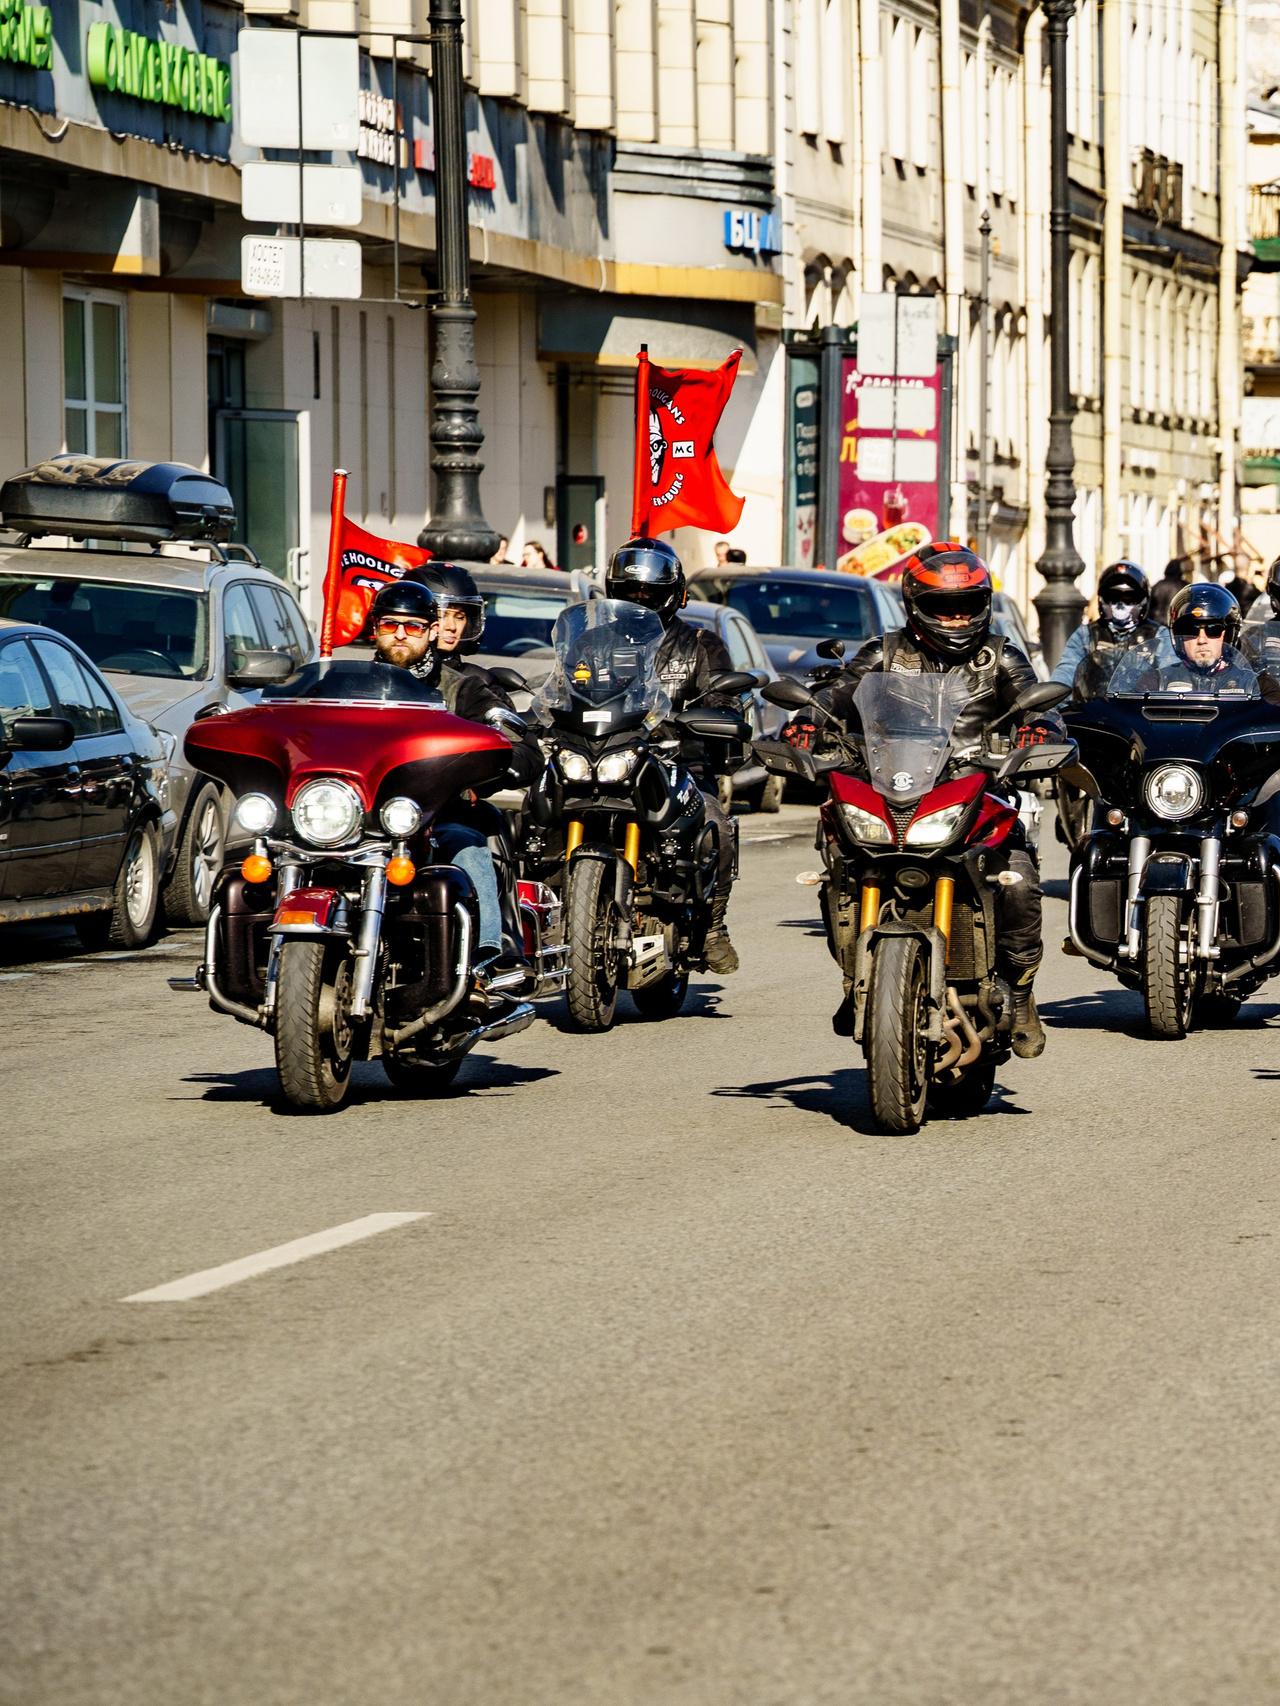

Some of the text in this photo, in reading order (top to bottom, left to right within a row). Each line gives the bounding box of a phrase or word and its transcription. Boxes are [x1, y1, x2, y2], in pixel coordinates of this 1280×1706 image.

[731, 210, 760, 253] БЦ
[674, 445, 693, 454] MC
[651, 472, 684, 506] ERSBURG
[349, 552, 405, 578] HOOLIG
